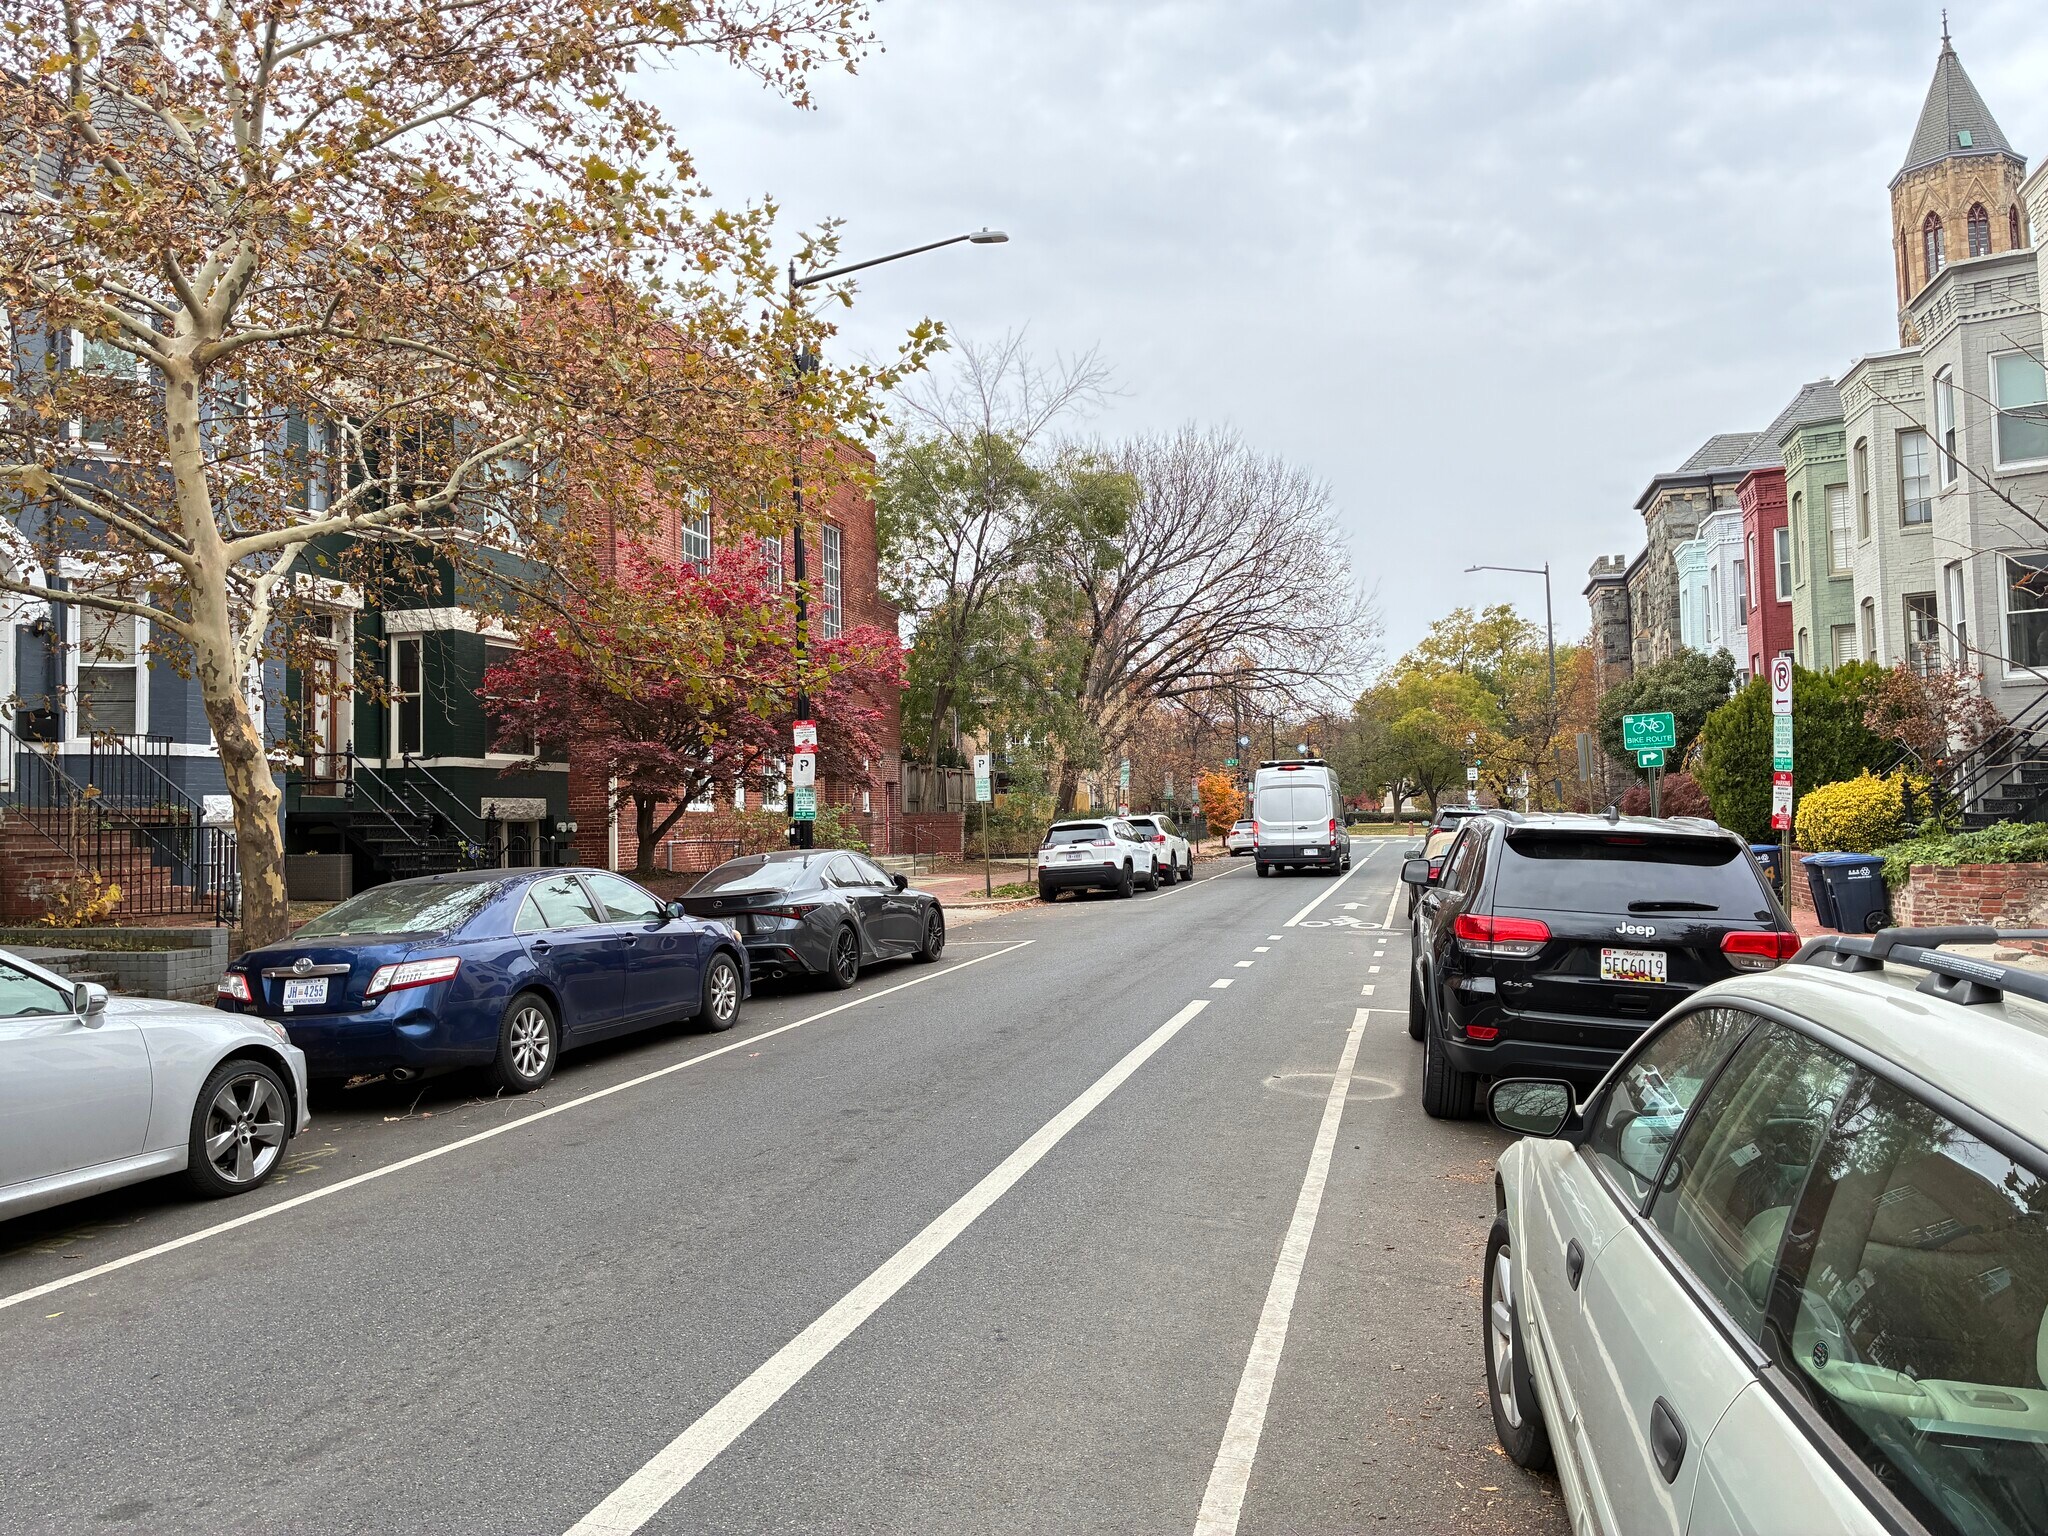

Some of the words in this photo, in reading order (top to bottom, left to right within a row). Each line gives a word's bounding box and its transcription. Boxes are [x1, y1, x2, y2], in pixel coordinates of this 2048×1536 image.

[1627, 736, 1645, 744] BIKE
[1645, 735, 1672, 743] ROUTE
[800, 759, 809, 771] P
[978, 759, 985, 768] P
[1615, 921, 1656, 938] Jeep
[1604, 956, 1663, 976] 5EC6019
[1502, 980, 1534, 988] 4x4
[287, 986, 298, 999] JH
[304, 985, 323, 998] 4255
